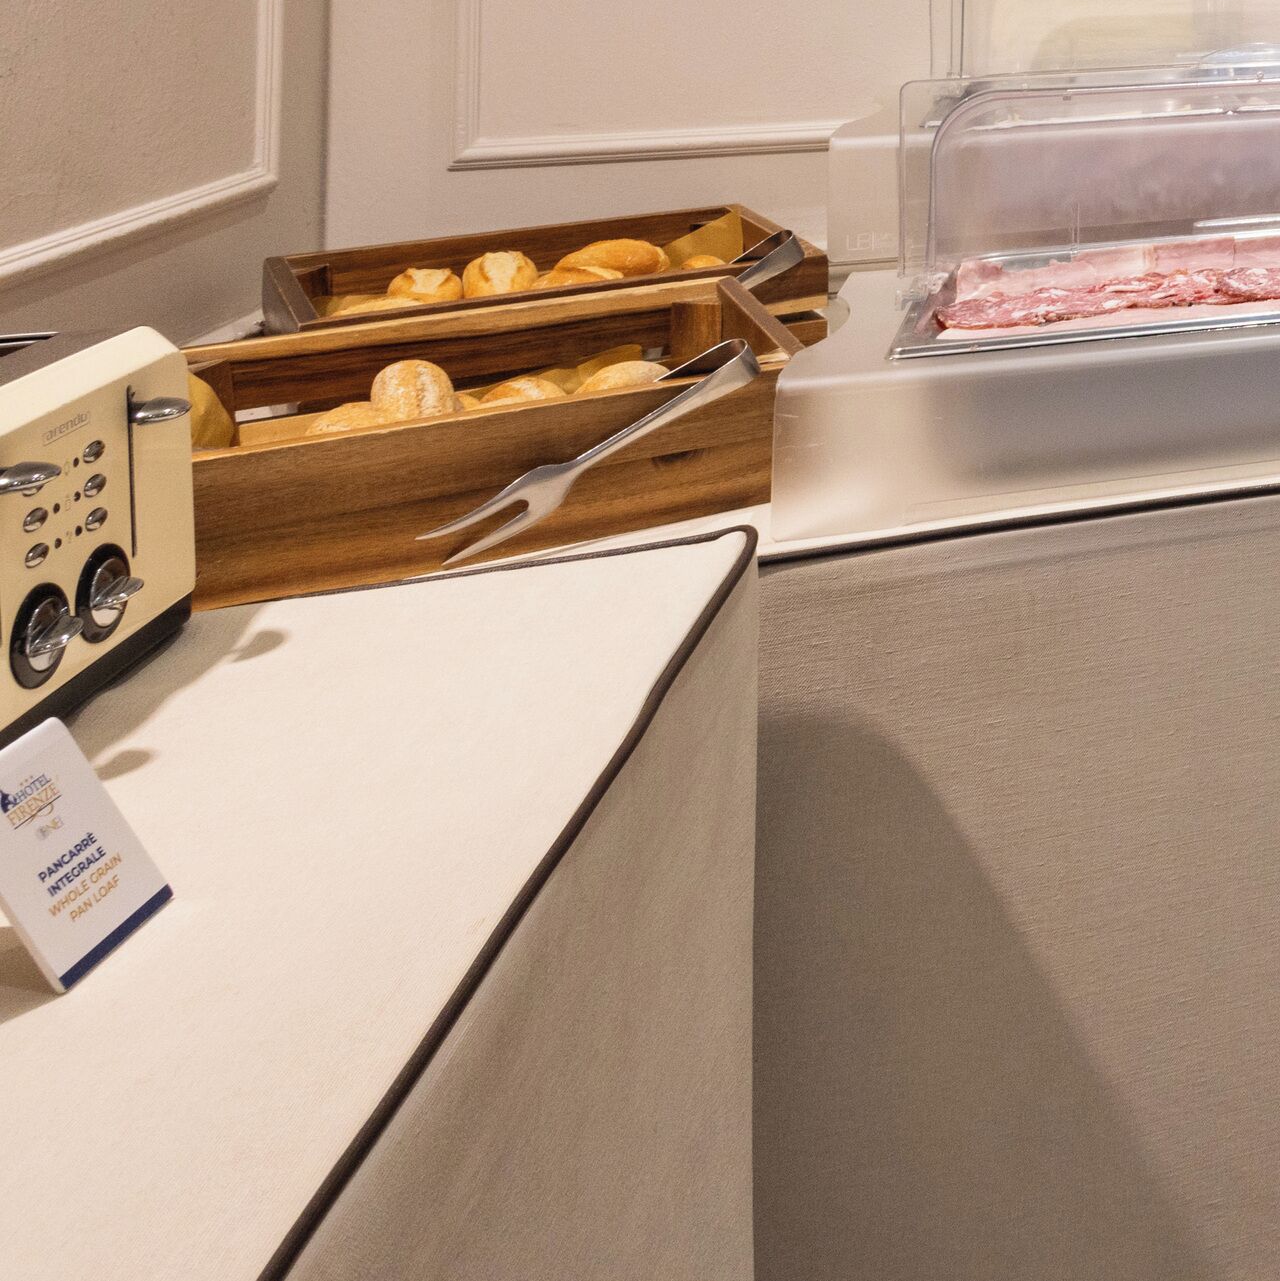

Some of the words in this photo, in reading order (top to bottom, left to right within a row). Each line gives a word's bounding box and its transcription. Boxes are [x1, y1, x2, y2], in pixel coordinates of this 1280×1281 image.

[6, 783, 60, 827] FIRENZE
[16, 774, 51, 802] HOTEL
[37, 832, 98, 883] PANCARRÈ
[47, 846, 107, 897] INTEGRALE
[48, 879, 90, 917] WHOLE
[89, 852, 122, 884] GRAIN
[69, 898, 93, 922] PAN
[93, 874, 120, 903] LOAF
